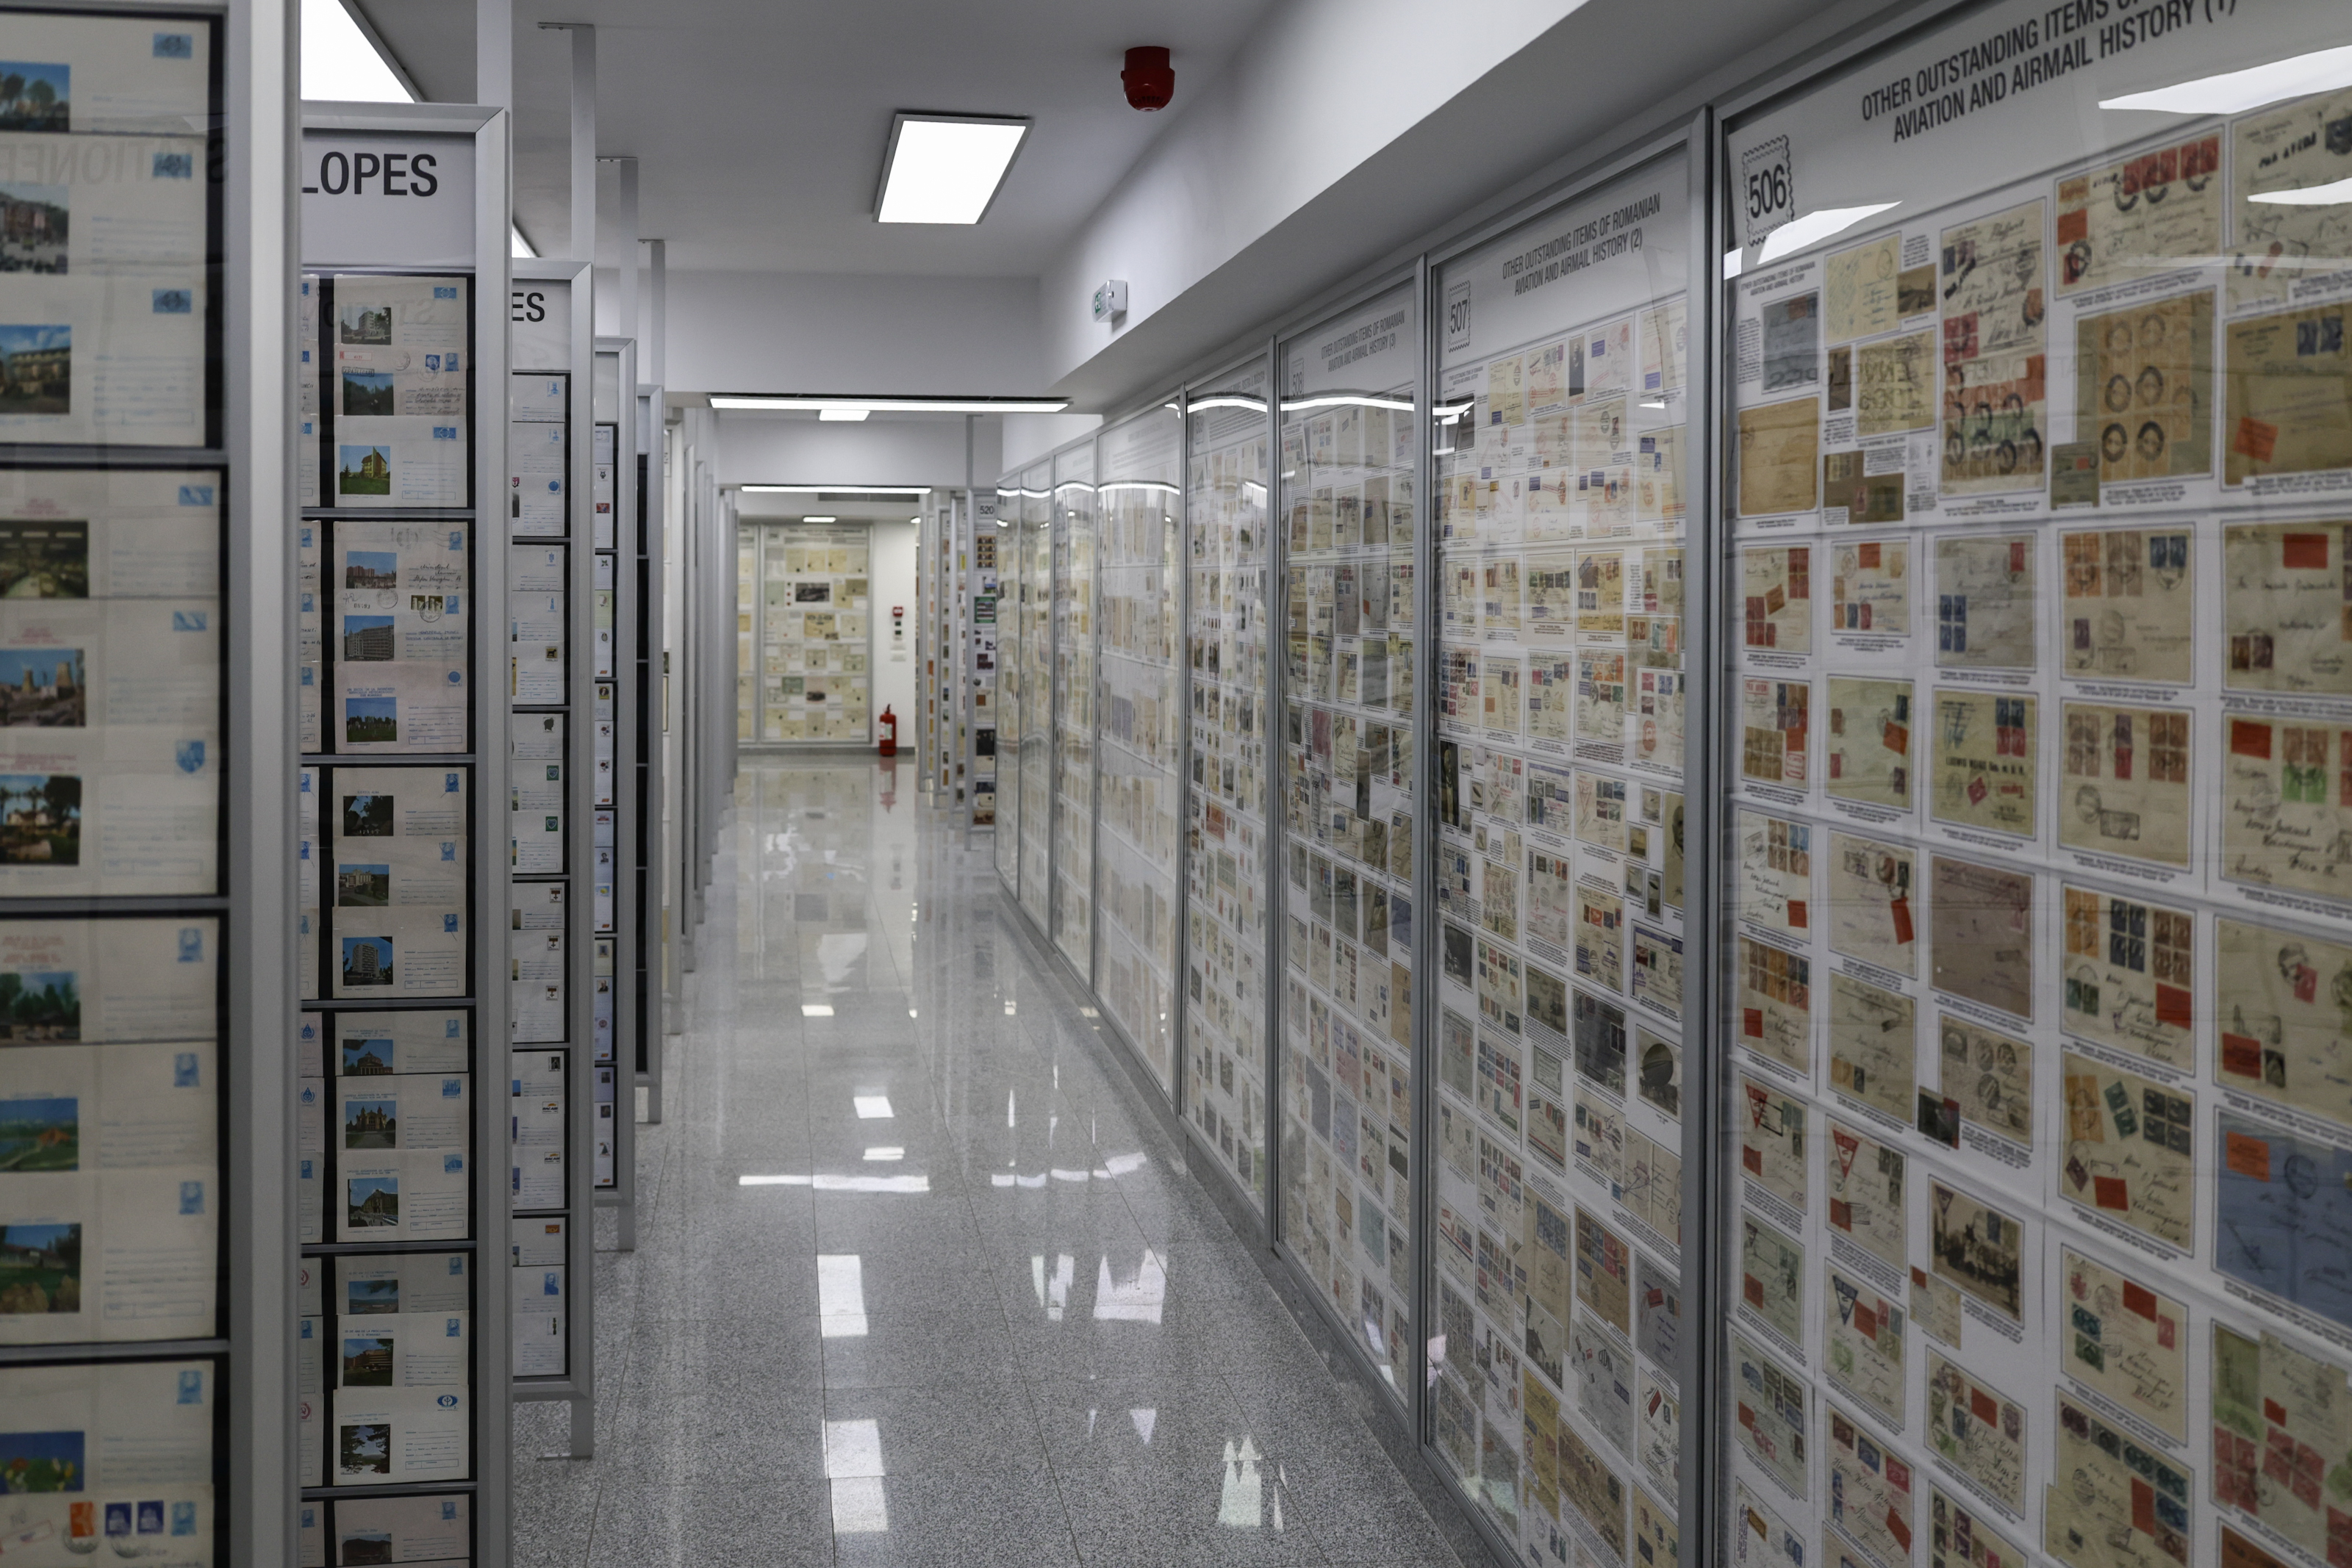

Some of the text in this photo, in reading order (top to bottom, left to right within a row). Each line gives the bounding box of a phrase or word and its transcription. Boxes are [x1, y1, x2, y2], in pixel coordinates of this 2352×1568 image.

[1862, 0, 2109, 121] OTHER OUTSTANDING ITEMS
[1894, 89, 1965, 143] AVIATION
[1970, 72, 2006, 112] AND
[2012, 37, 2093, 95] AIRMAIL
[2101, 0, 2195, 59] HISTORY
[1749, 164, 1787, 218] 506
[1502, 192, 1660, 280] OTHER OUTSTANDING ITEMS OF ROMANIAN
[1514, 226, 1643, 297] AVIATION AND AIRMAIL HISTORY (2)
[1321, 309, 1405, 359] OTHER OUTSTANDING ITEMS OF ROMANIAN
[1450, 299, 1468, 334] 507
[1327, 355, 1344, 373] AVIATION
[1344, 350, 1352, 366] AND
[1352, 344, 1369, 362] AIRMAIL
[1369, 335, 1389, 356] HISTORY
[1292, 371, 1302, 397] 508
[980, 506, 994, 514] 520
